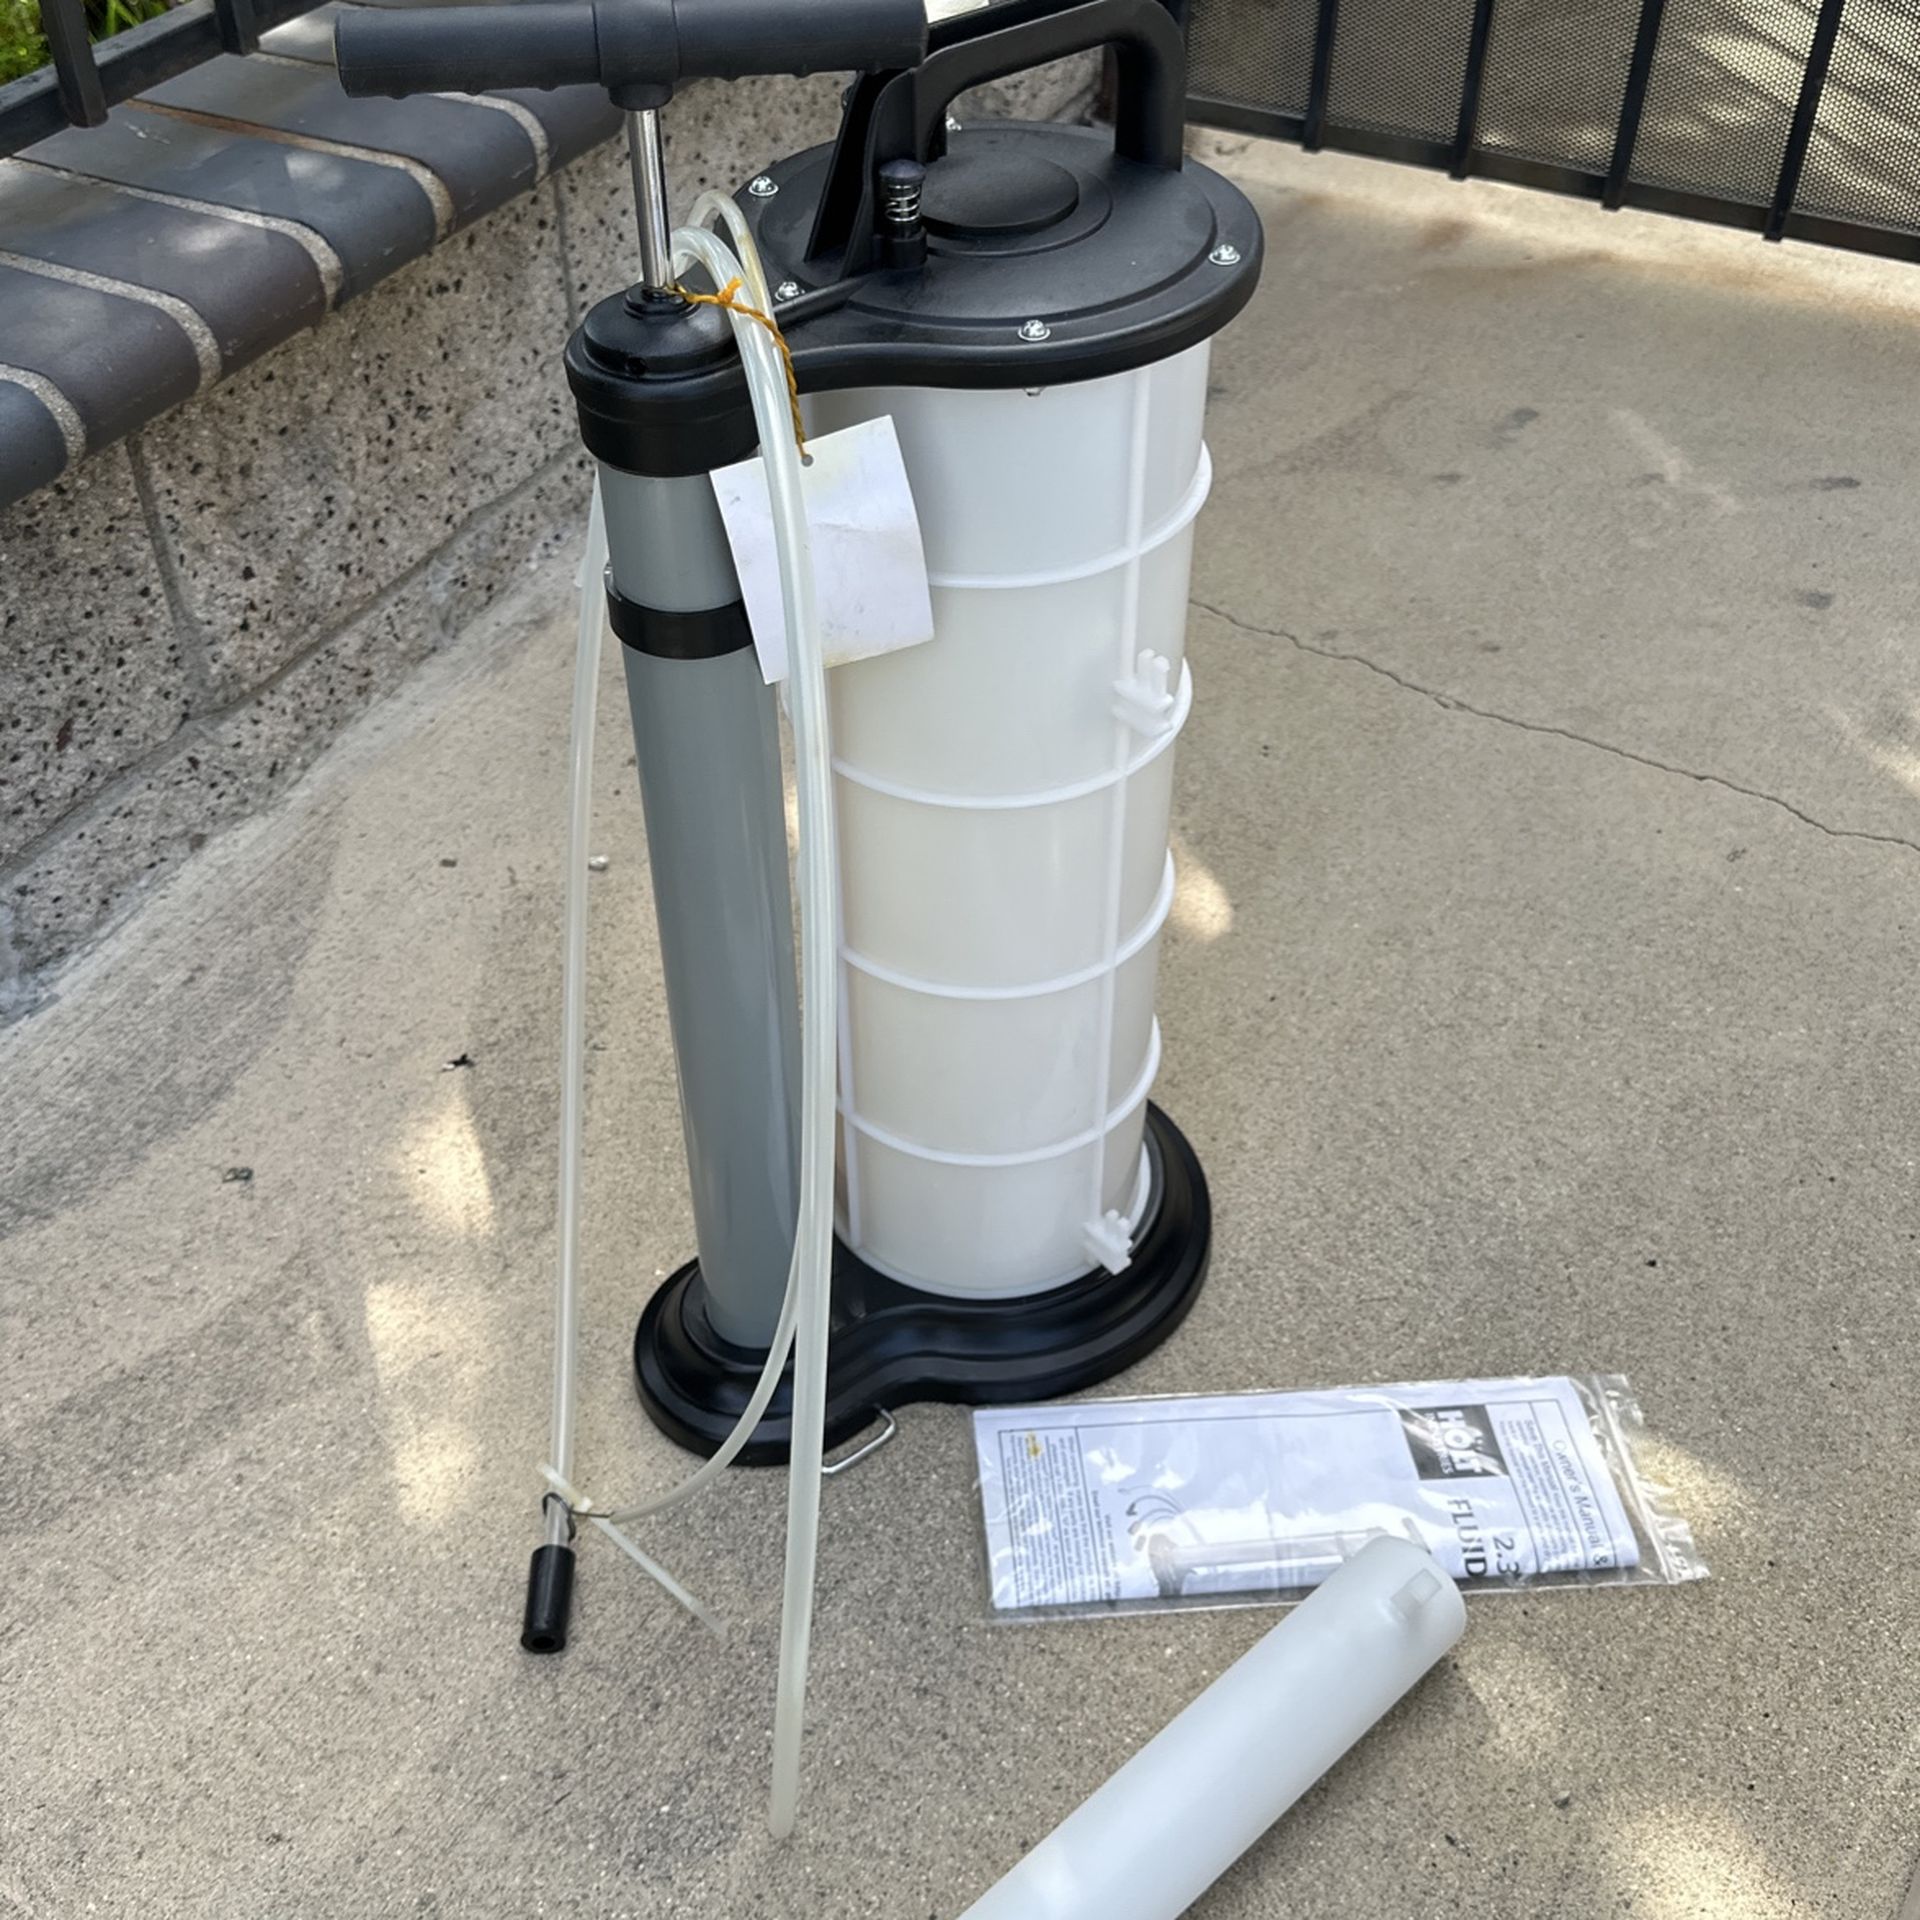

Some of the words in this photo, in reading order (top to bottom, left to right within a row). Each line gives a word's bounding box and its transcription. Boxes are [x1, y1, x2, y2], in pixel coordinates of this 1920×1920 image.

[1449, 1499, 1488, 1577] FLUID
[1553, 1440, 1581, 1493] Owner's
[1574, 1497, 1603, 1549] Manual
[1592, 1552, 1609, 1566] &
[1492, 1535, 1521, 1577] 2.3
